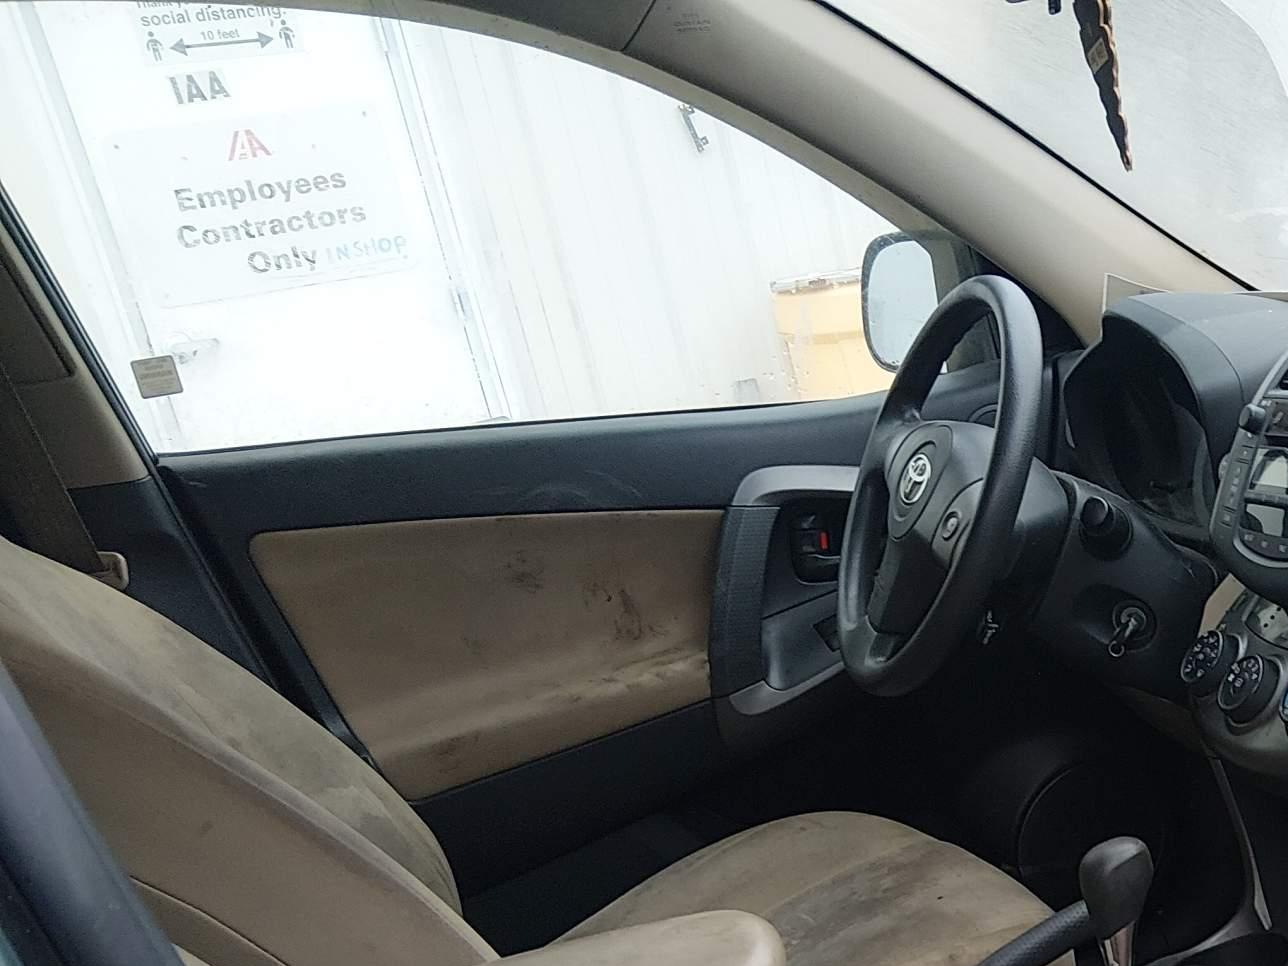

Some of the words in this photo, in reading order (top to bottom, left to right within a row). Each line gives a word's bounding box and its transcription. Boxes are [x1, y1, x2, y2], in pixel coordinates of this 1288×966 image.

[140, 9, 192, 27] social
[200, 30, 215, 41] 10
[217, 28, 241, 40] feet
[168, 70, 232, 105] IAA
[174, 171, 347, 212] Employees
[176, 204, 367, 249] Contractors
[247, 245, 318, 273] Only
